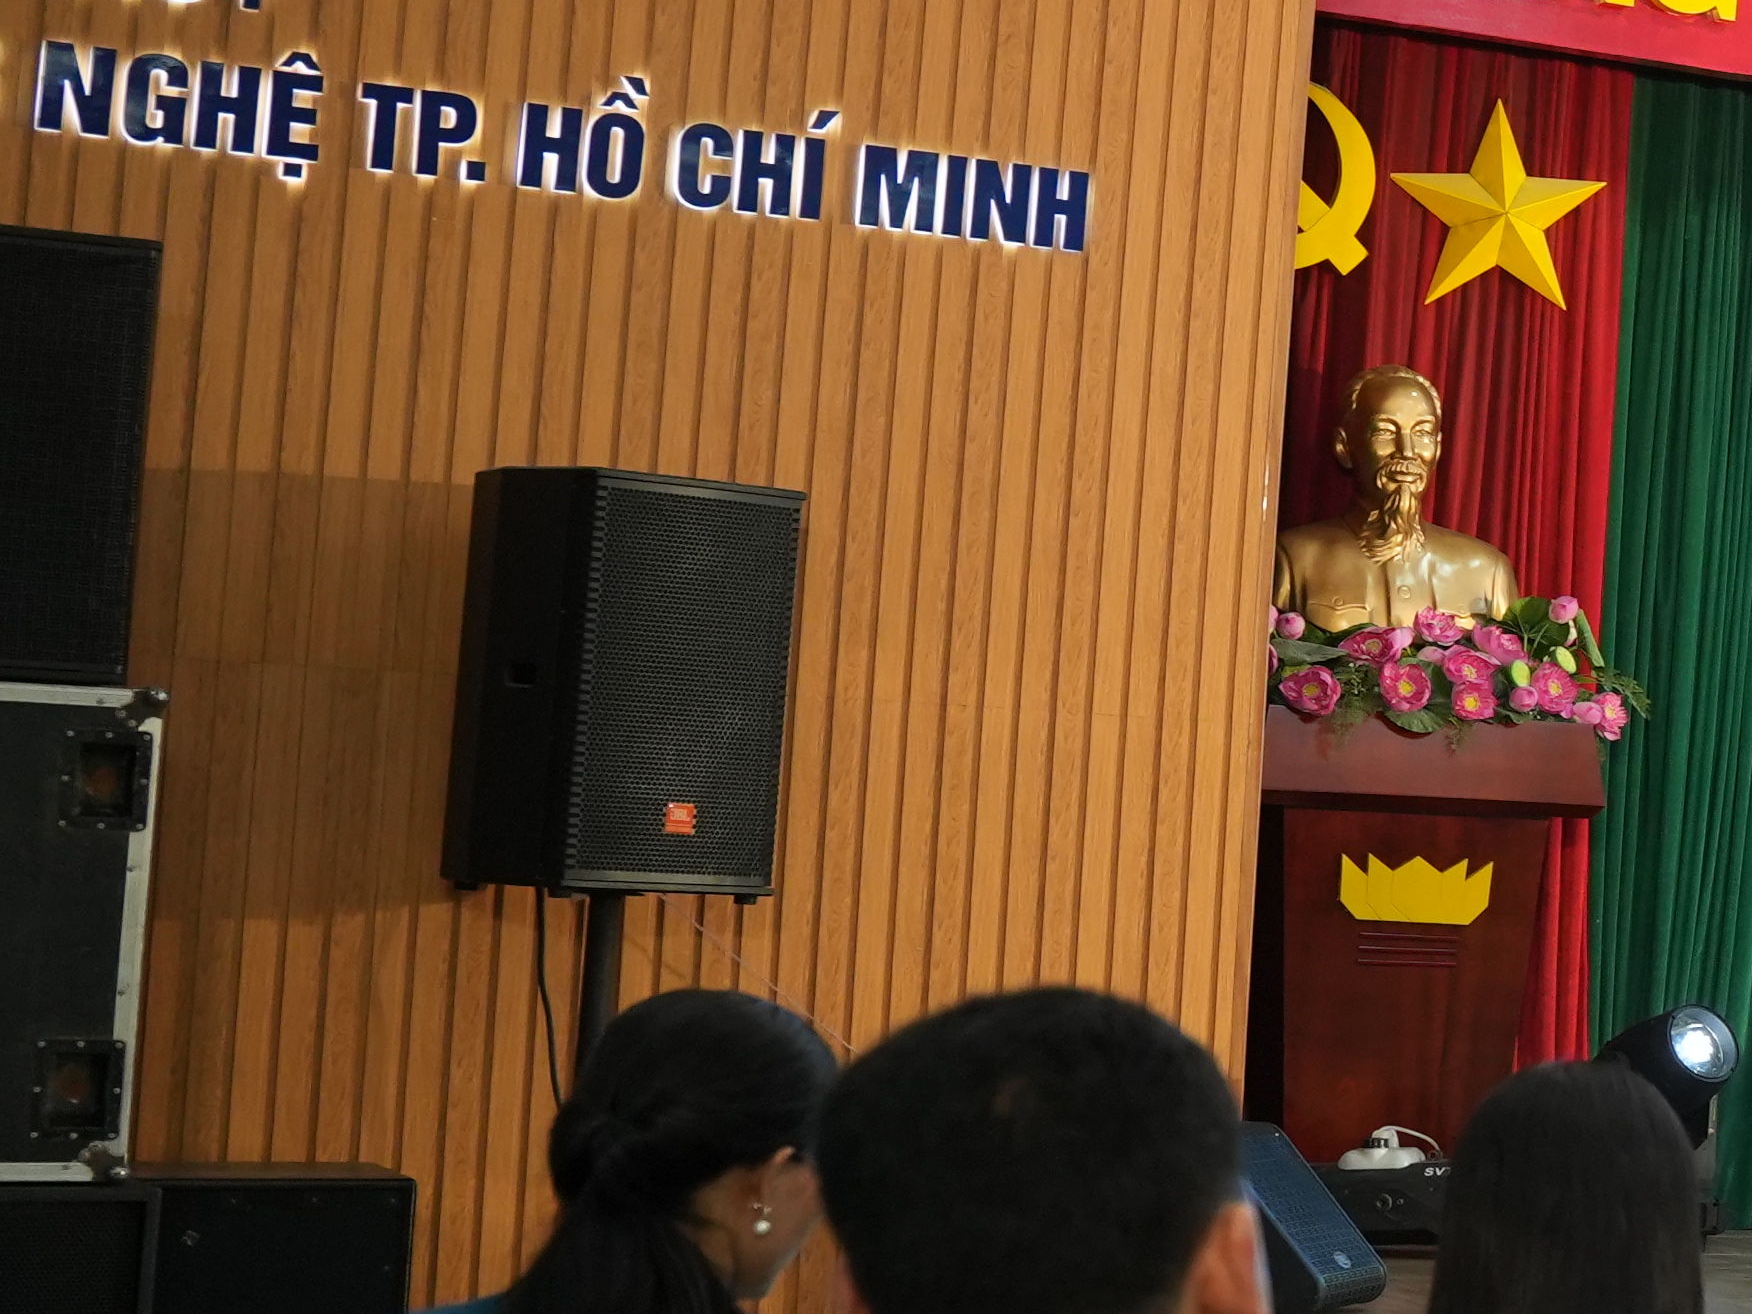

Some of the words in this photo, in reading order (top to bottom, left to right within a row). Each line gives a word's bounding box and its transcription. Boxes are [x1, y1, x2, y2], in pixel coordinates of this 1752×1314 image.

[33, 40, 325, 183] NGHỆ
[358, 82, 487, 183] TP.
[515, 76, 652, 200] HỒ
[672, 112, 843, 222] CHÍ
[857, 144, 1091, 252] MINH
